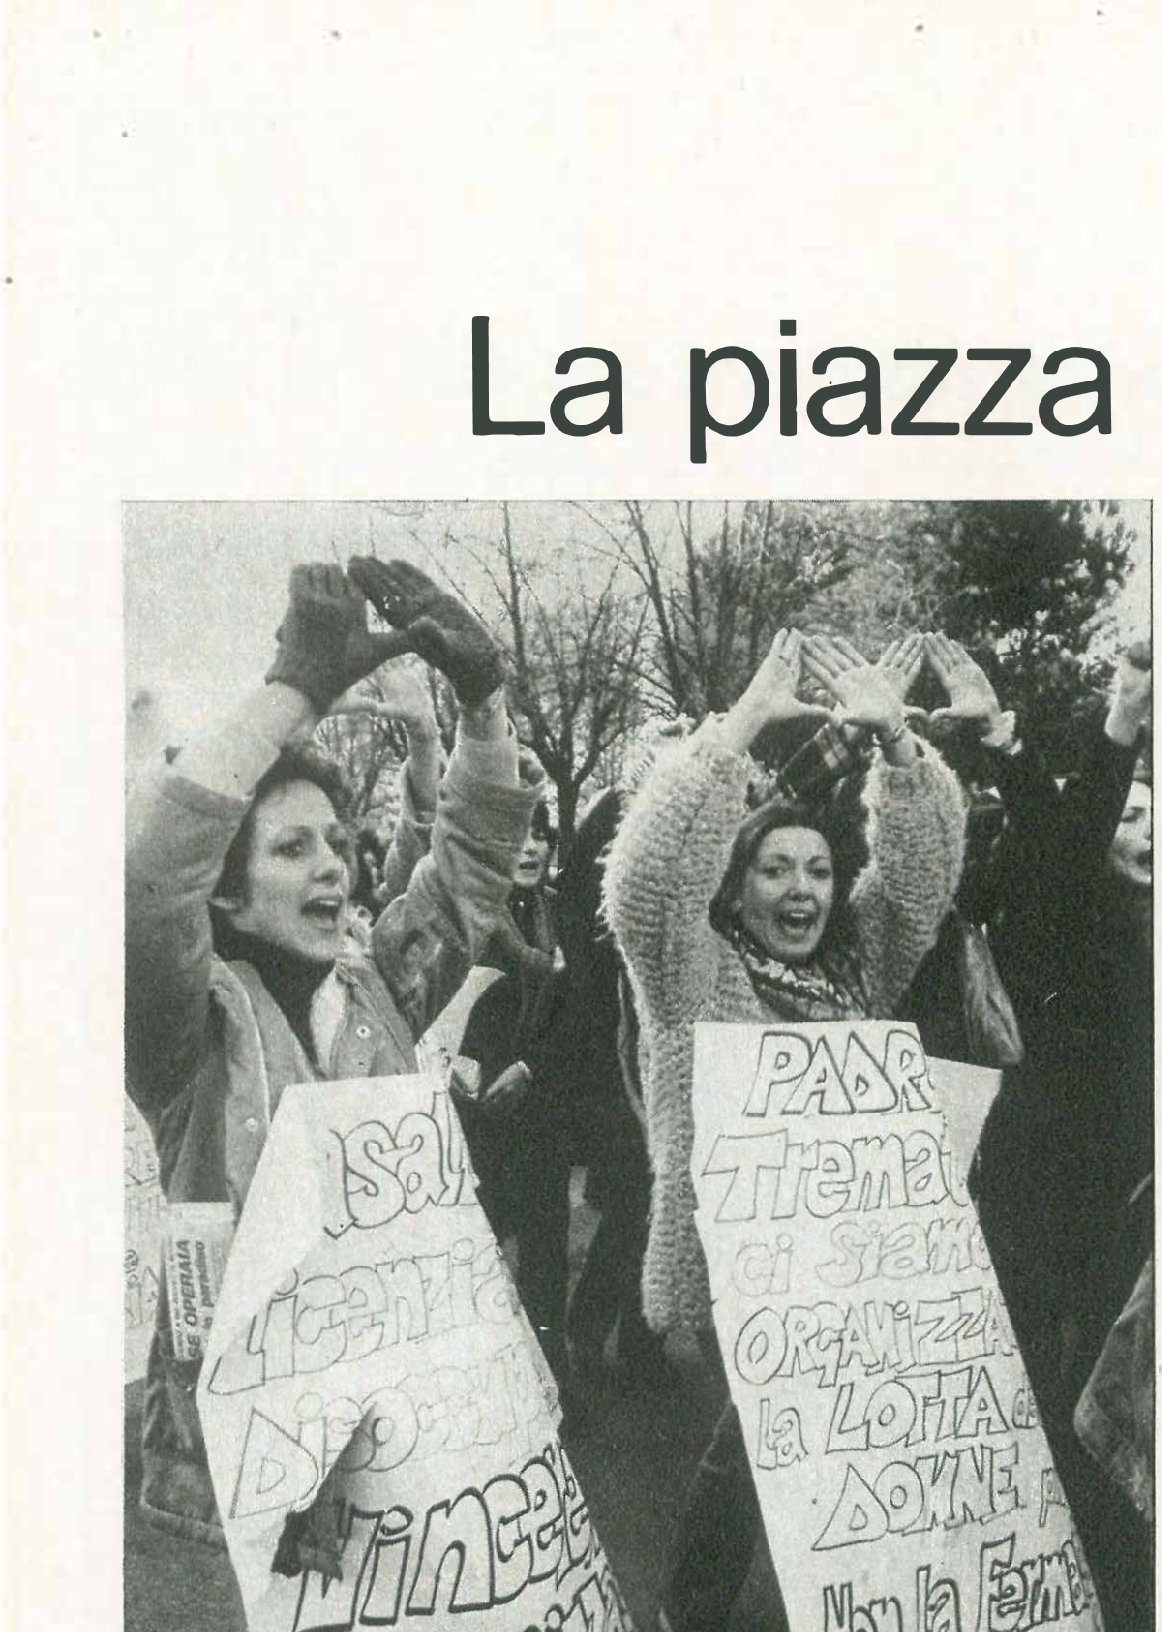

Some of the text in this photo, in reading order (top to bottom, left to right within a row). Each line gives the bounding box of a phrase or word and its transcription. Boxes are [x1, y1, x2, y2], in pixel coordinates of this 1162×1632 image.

[471, 315, 623, 437] La
[689, 319, 1112, 464] piazza
[176, 1239, 198, 1326] OPERAIA
